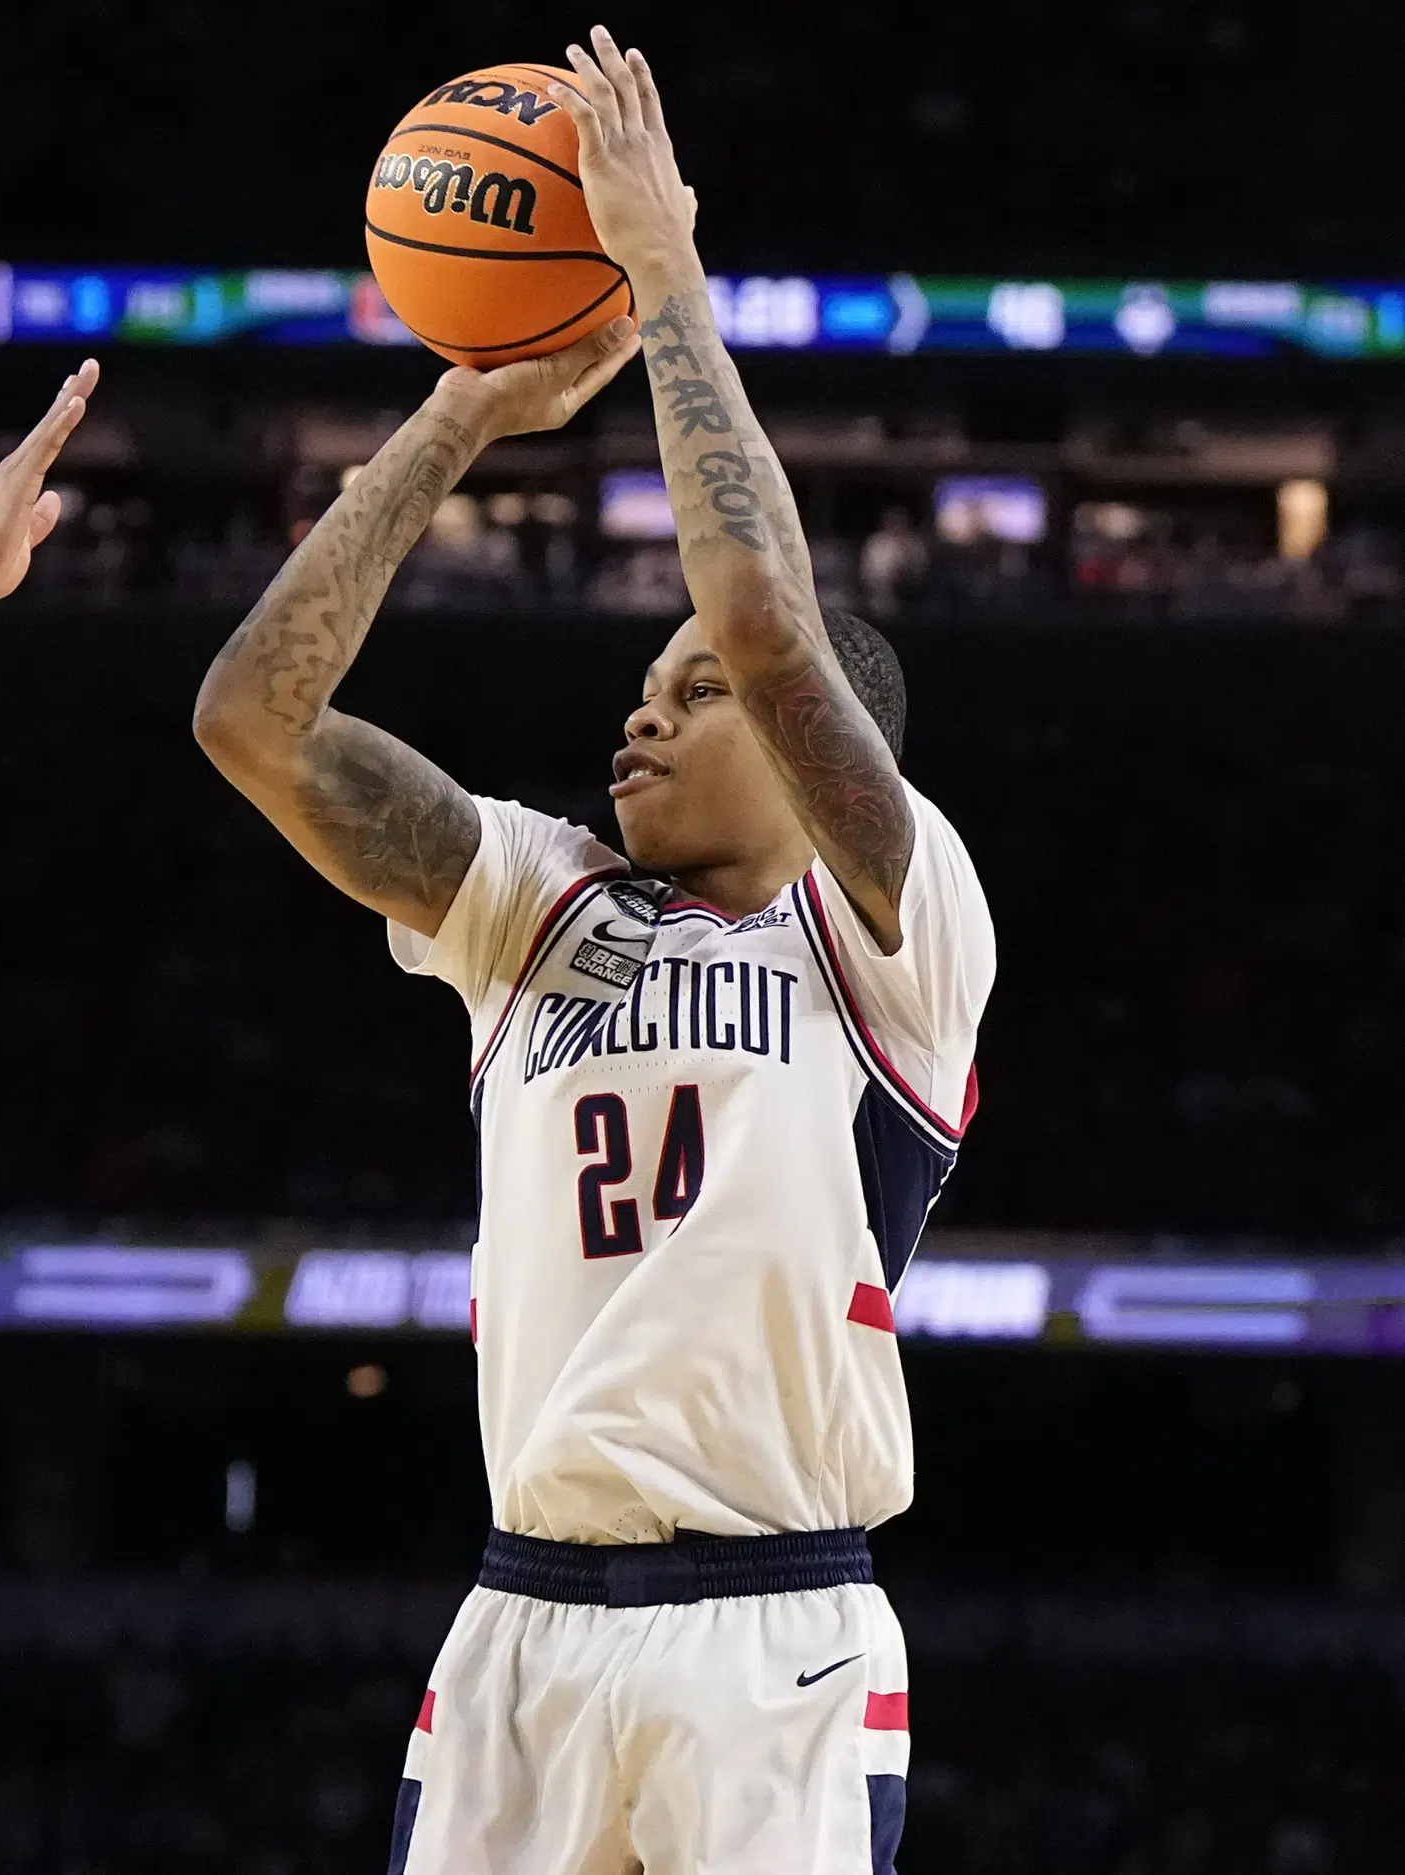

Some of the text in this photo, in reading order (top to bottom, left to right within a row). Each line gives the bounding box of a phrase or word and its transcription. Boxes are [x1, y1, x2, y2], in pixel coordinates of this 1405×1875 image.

[373, 153, 538, 236] Wilson
[418, 144, 471, 161] EVO NXT
[638, 312, 733, 440] FEAR
[524, 957, 799, 1085] CONECTICUT
[573, 956, 633, 987] CHANGE
[573, 1083, 706, 1260] 24
